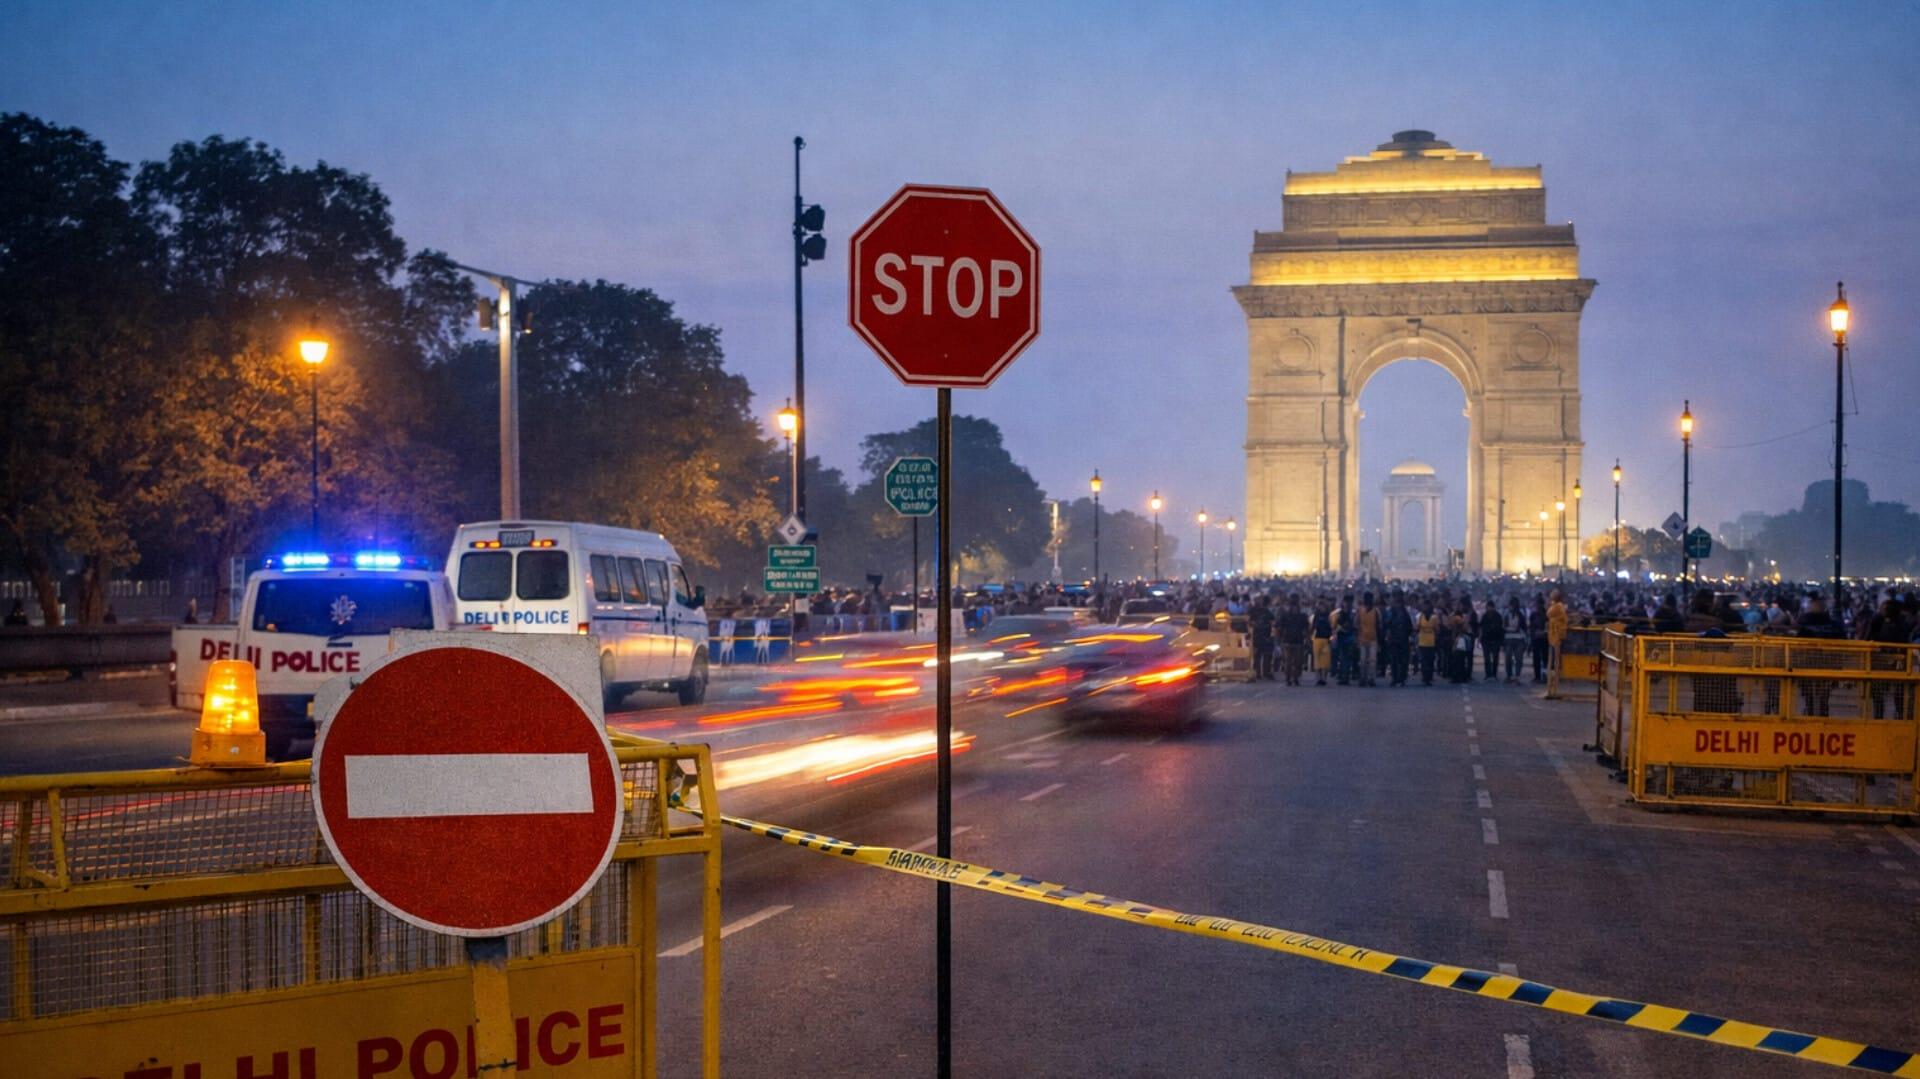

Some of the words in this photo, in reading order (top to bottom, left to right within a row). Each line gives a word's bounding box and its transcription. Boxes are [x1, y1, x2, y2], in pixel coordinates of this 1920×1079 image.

[872, 253, 1022, 319] STOP
[513, 610, 569, 624] POLICE
[272, 651, 360, 672] POLICE
[1695, 729, 1759, 753] DELHI
[1773, 731, 1856, 756] POLICE
